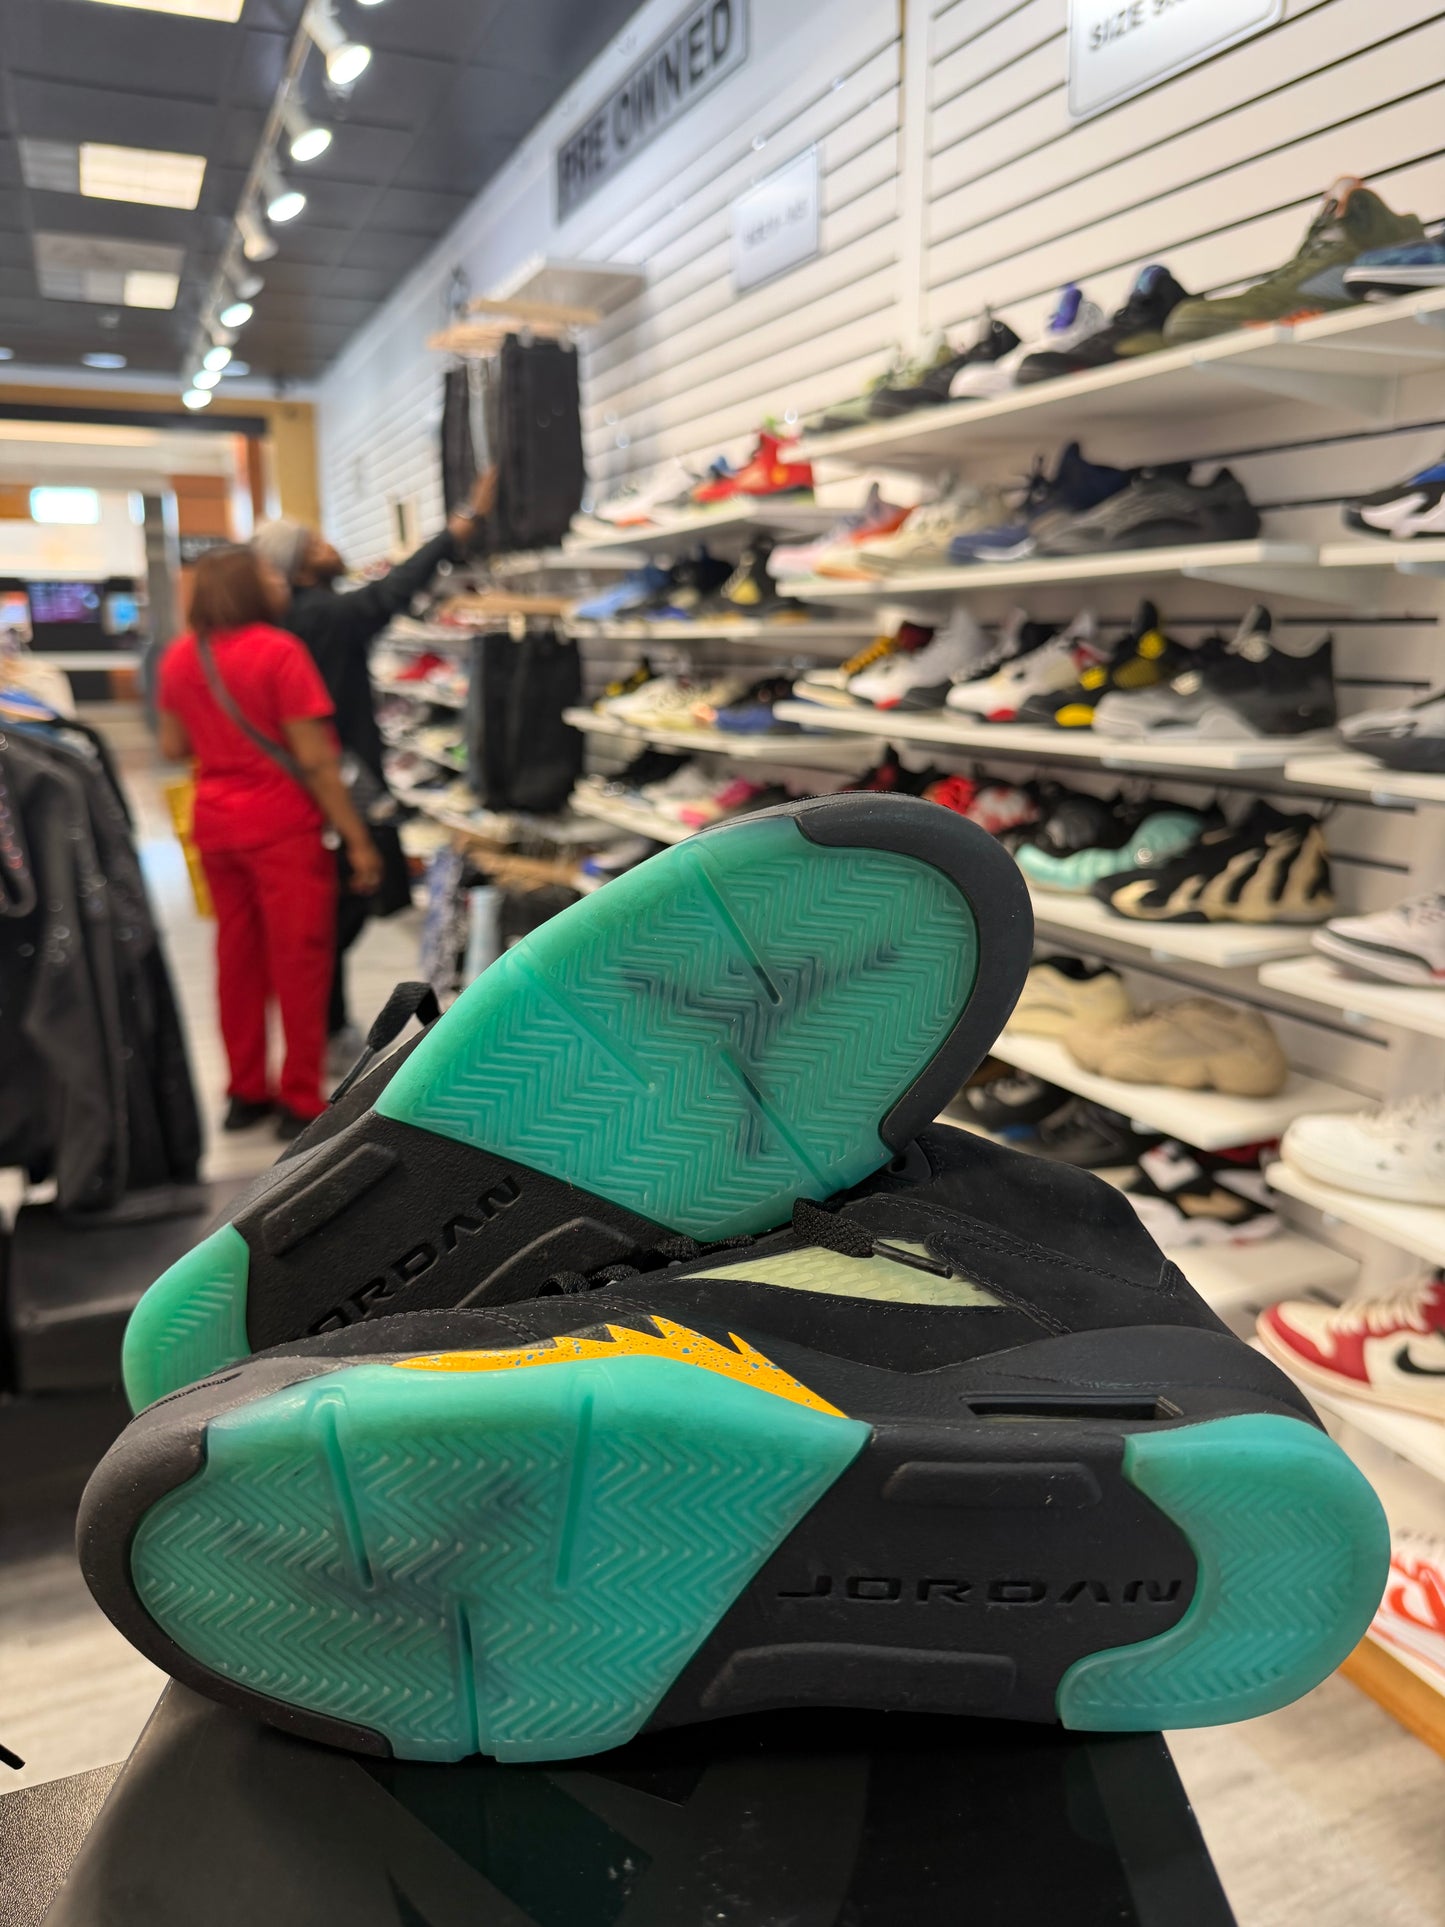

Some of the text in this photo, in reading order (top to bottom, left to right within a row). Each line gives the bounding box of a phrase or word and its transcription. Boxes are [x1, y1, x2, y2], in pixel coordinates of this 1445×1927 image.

[1089, 0, 1144, 51] SIZE
[560, 0, 731, 183] PRE OWNED
[309, 1175, 522, 1333] ORDAN
[777, 1575, 1182, 1604] JORDAN
